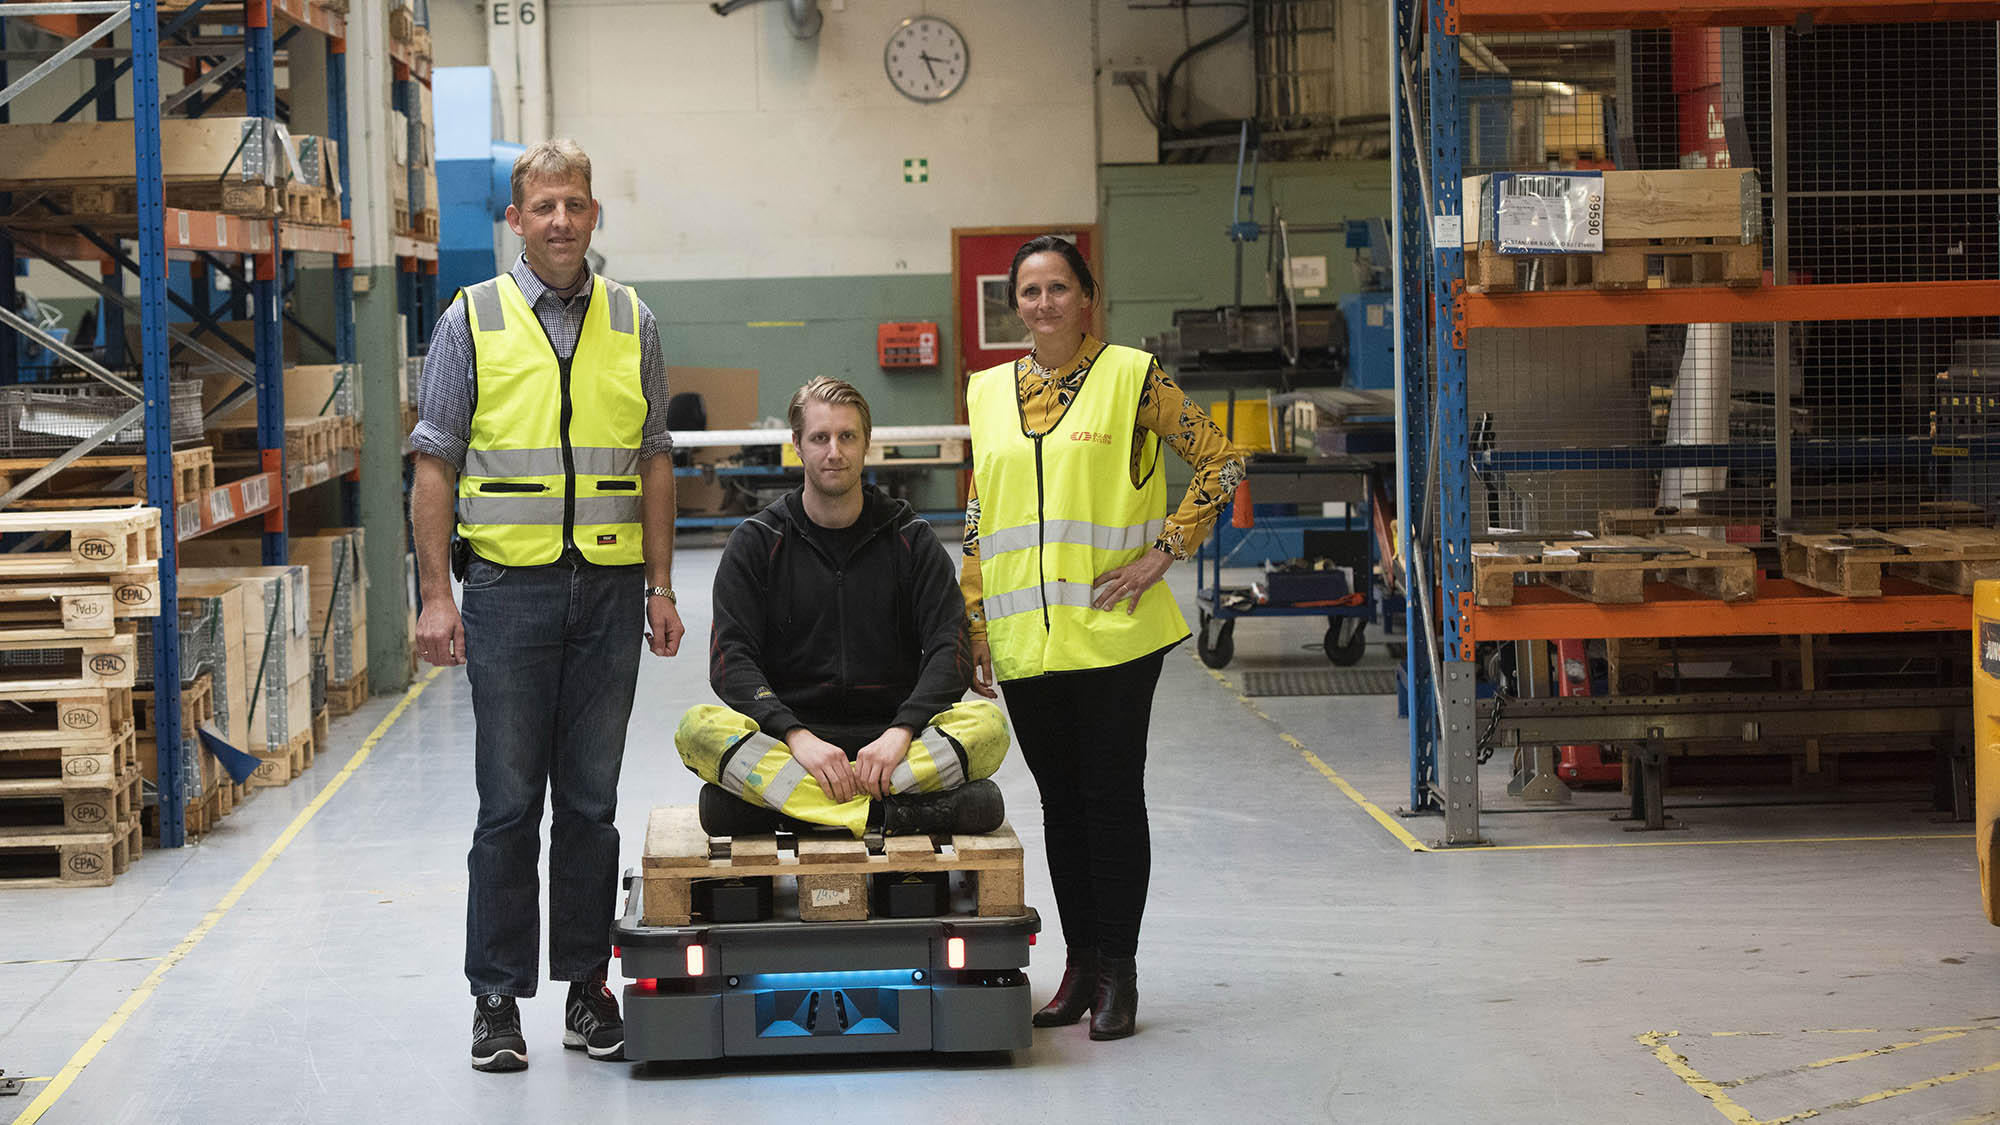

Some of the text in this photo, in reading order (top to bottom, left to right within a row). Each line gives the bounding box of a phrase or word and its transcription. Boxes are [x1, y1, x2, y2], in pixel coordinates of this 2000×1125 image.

[494, 2, 535, 25] E 6
[1588, 194, 1601, 236] 89590
[84, 543, 108, 555] EPAL
[121, 589, 145, 600] EPAL
[95, 658, 119, 670] EPAL
[68, 712, 92, 724] EPAL
[73, 759, 92, 773] EUR
[77, 807, 101, 819] EPAL
[74, 857, 99, 869] EPAL
